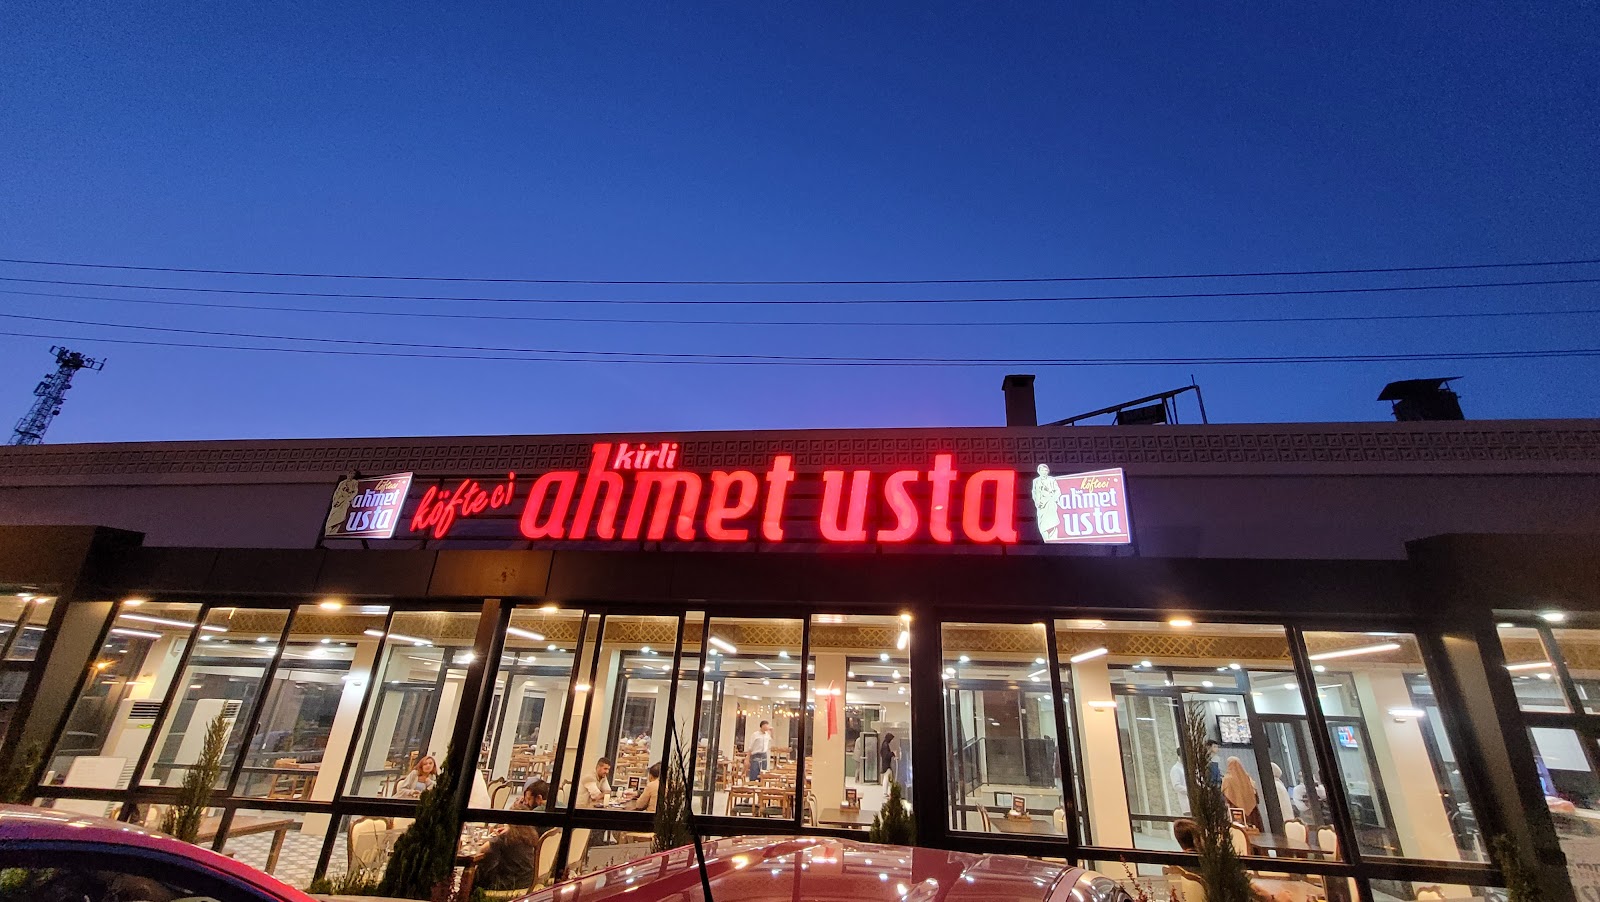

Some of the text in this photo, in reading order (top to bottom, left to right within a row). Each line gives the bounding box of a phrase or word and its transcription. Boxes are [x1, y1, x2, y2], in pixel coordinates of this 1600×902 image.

[614, 443, 677, 470] kirli
[351, 489, 400, 508] ahmet
[411, 443, 1018, 541] köfteci ahmet usta
[1059, 488, 1117, 510] ahmet
[346, 506, 393, 531] usta
[1063, 507, 1121, 536] usta
